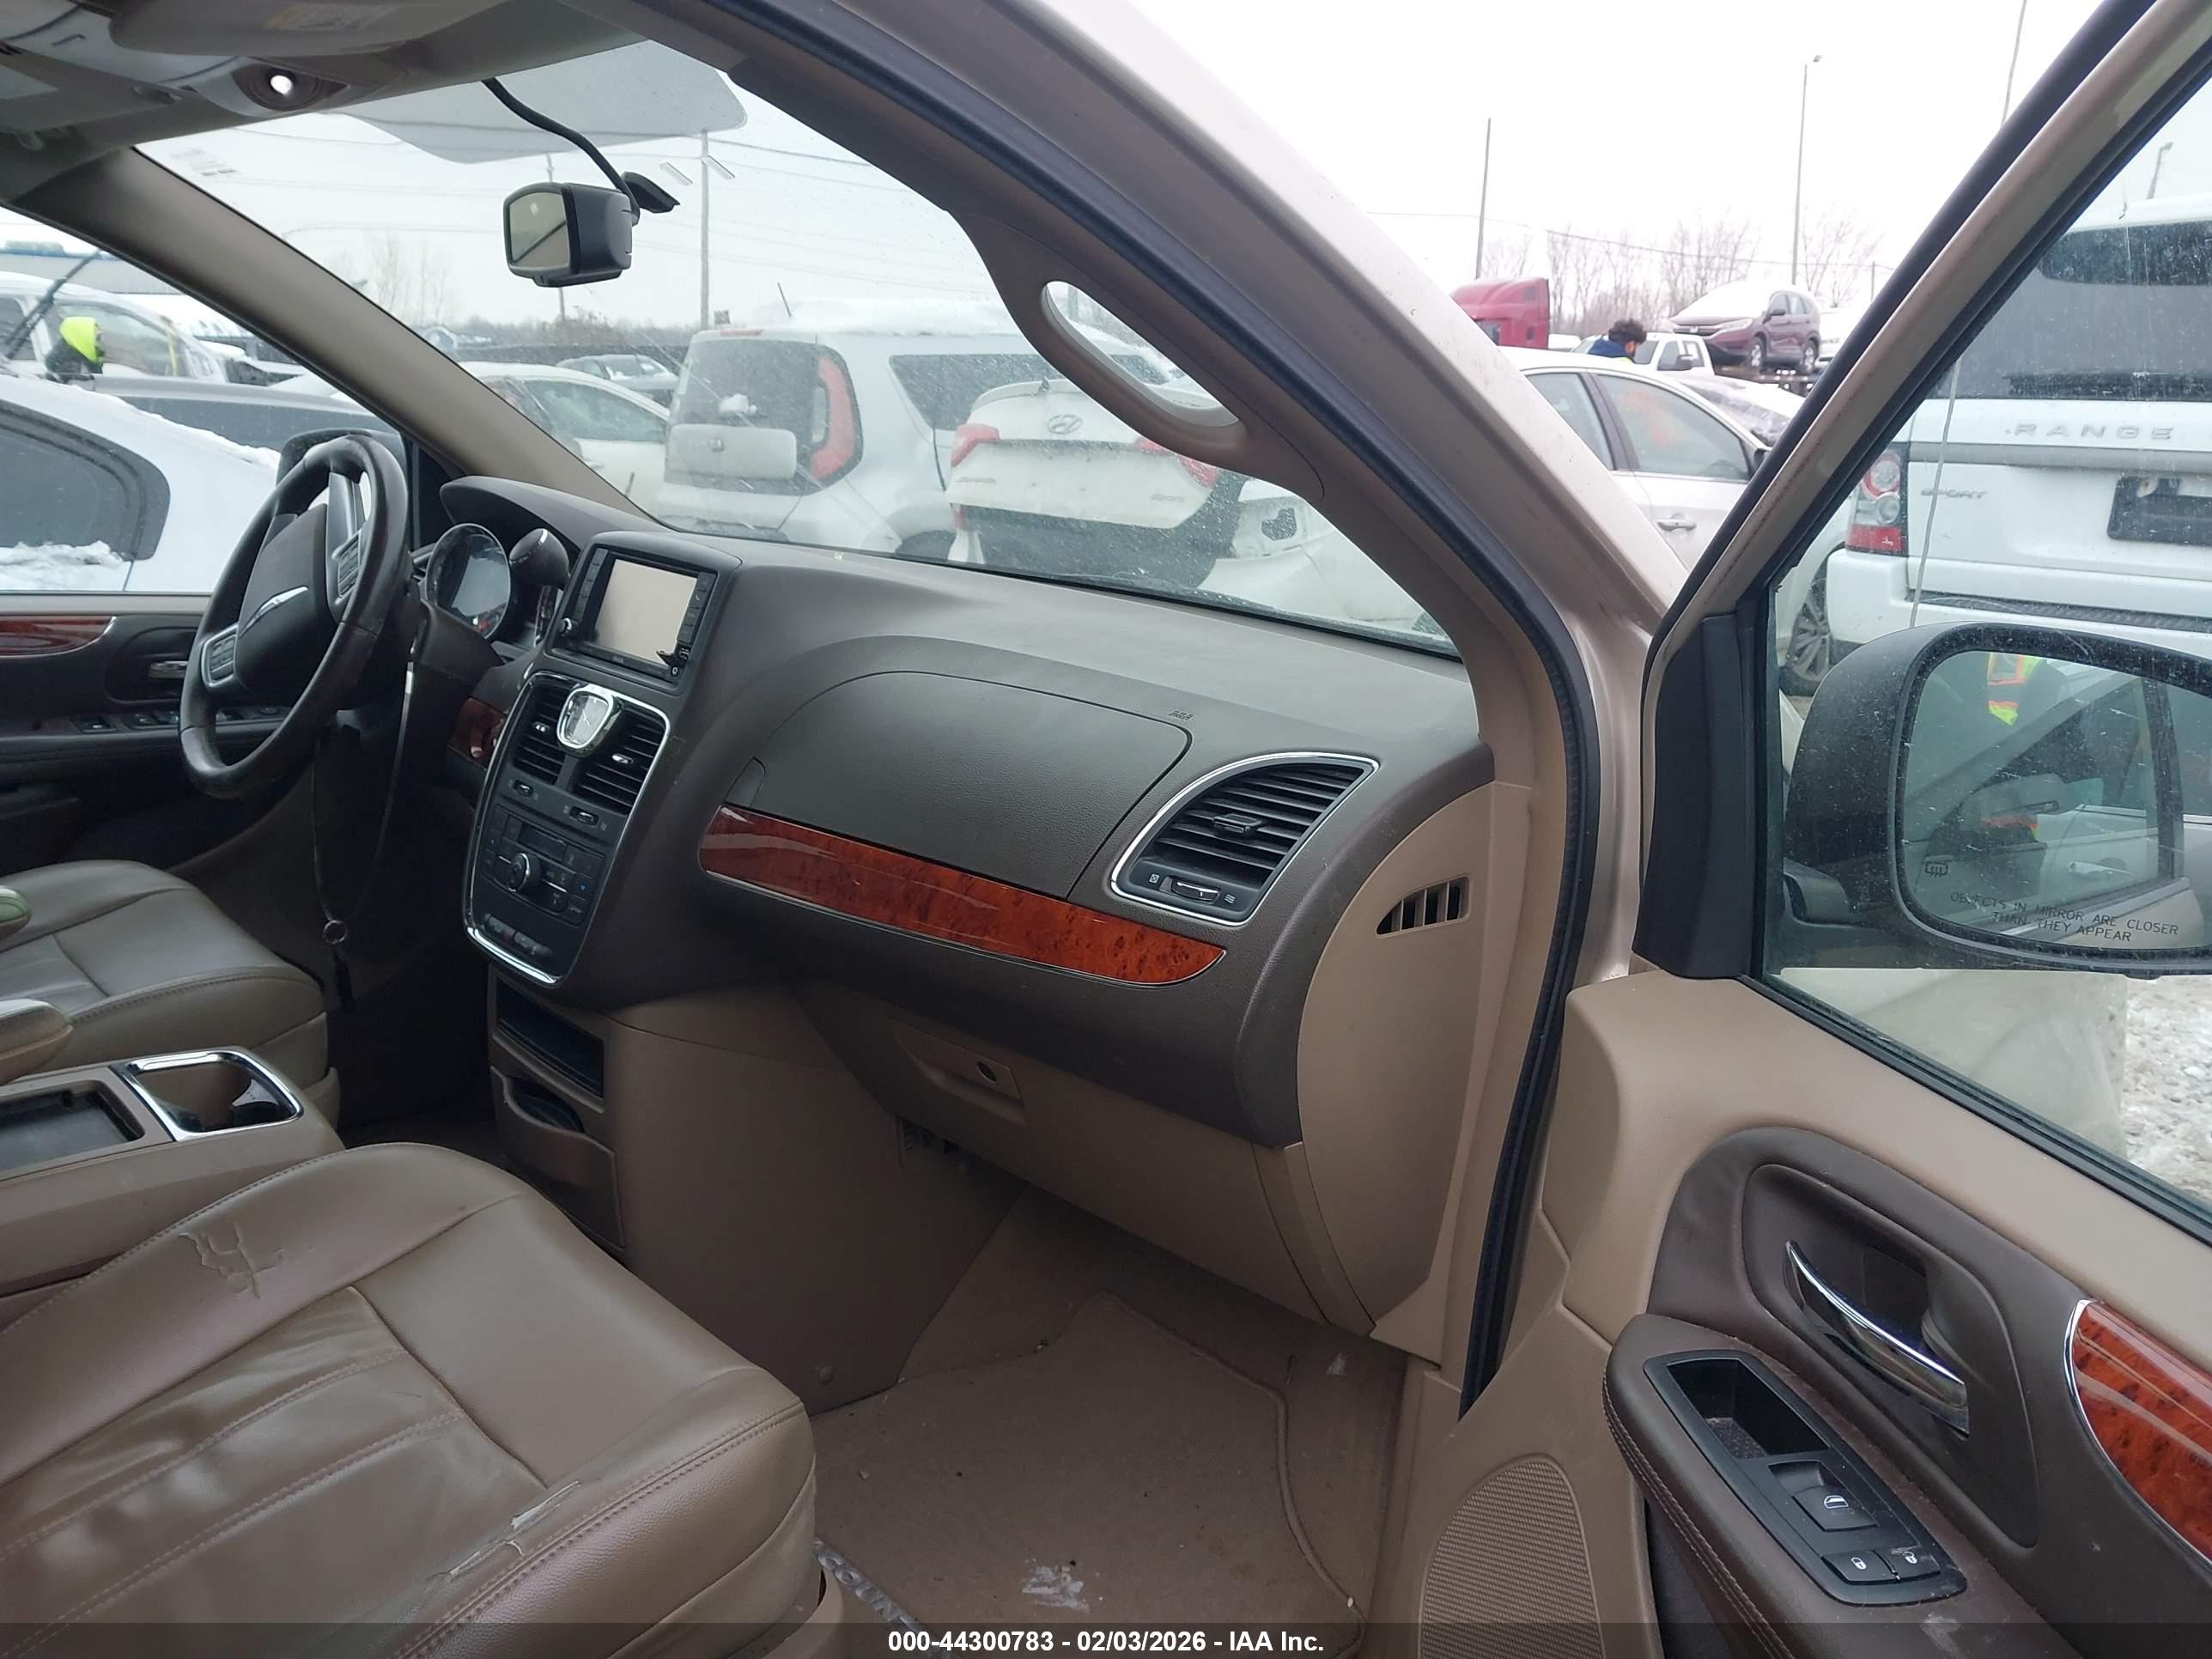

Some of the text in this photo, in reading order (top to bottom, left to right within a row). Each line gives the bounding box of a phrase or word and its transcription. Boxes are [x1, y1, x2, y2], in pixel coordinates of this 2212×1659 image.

[2014, 423, 2173, 440] RANGE
[1992, 911, 2132, 942] THAN THEY APPEAR
[2014, 901, 2027, 911] IN
[2035, 904, 2084, 921] MIRROR
[2092, 914, 2117, 927] ARE
[2126, 919, 2179, 935] CLOSER
